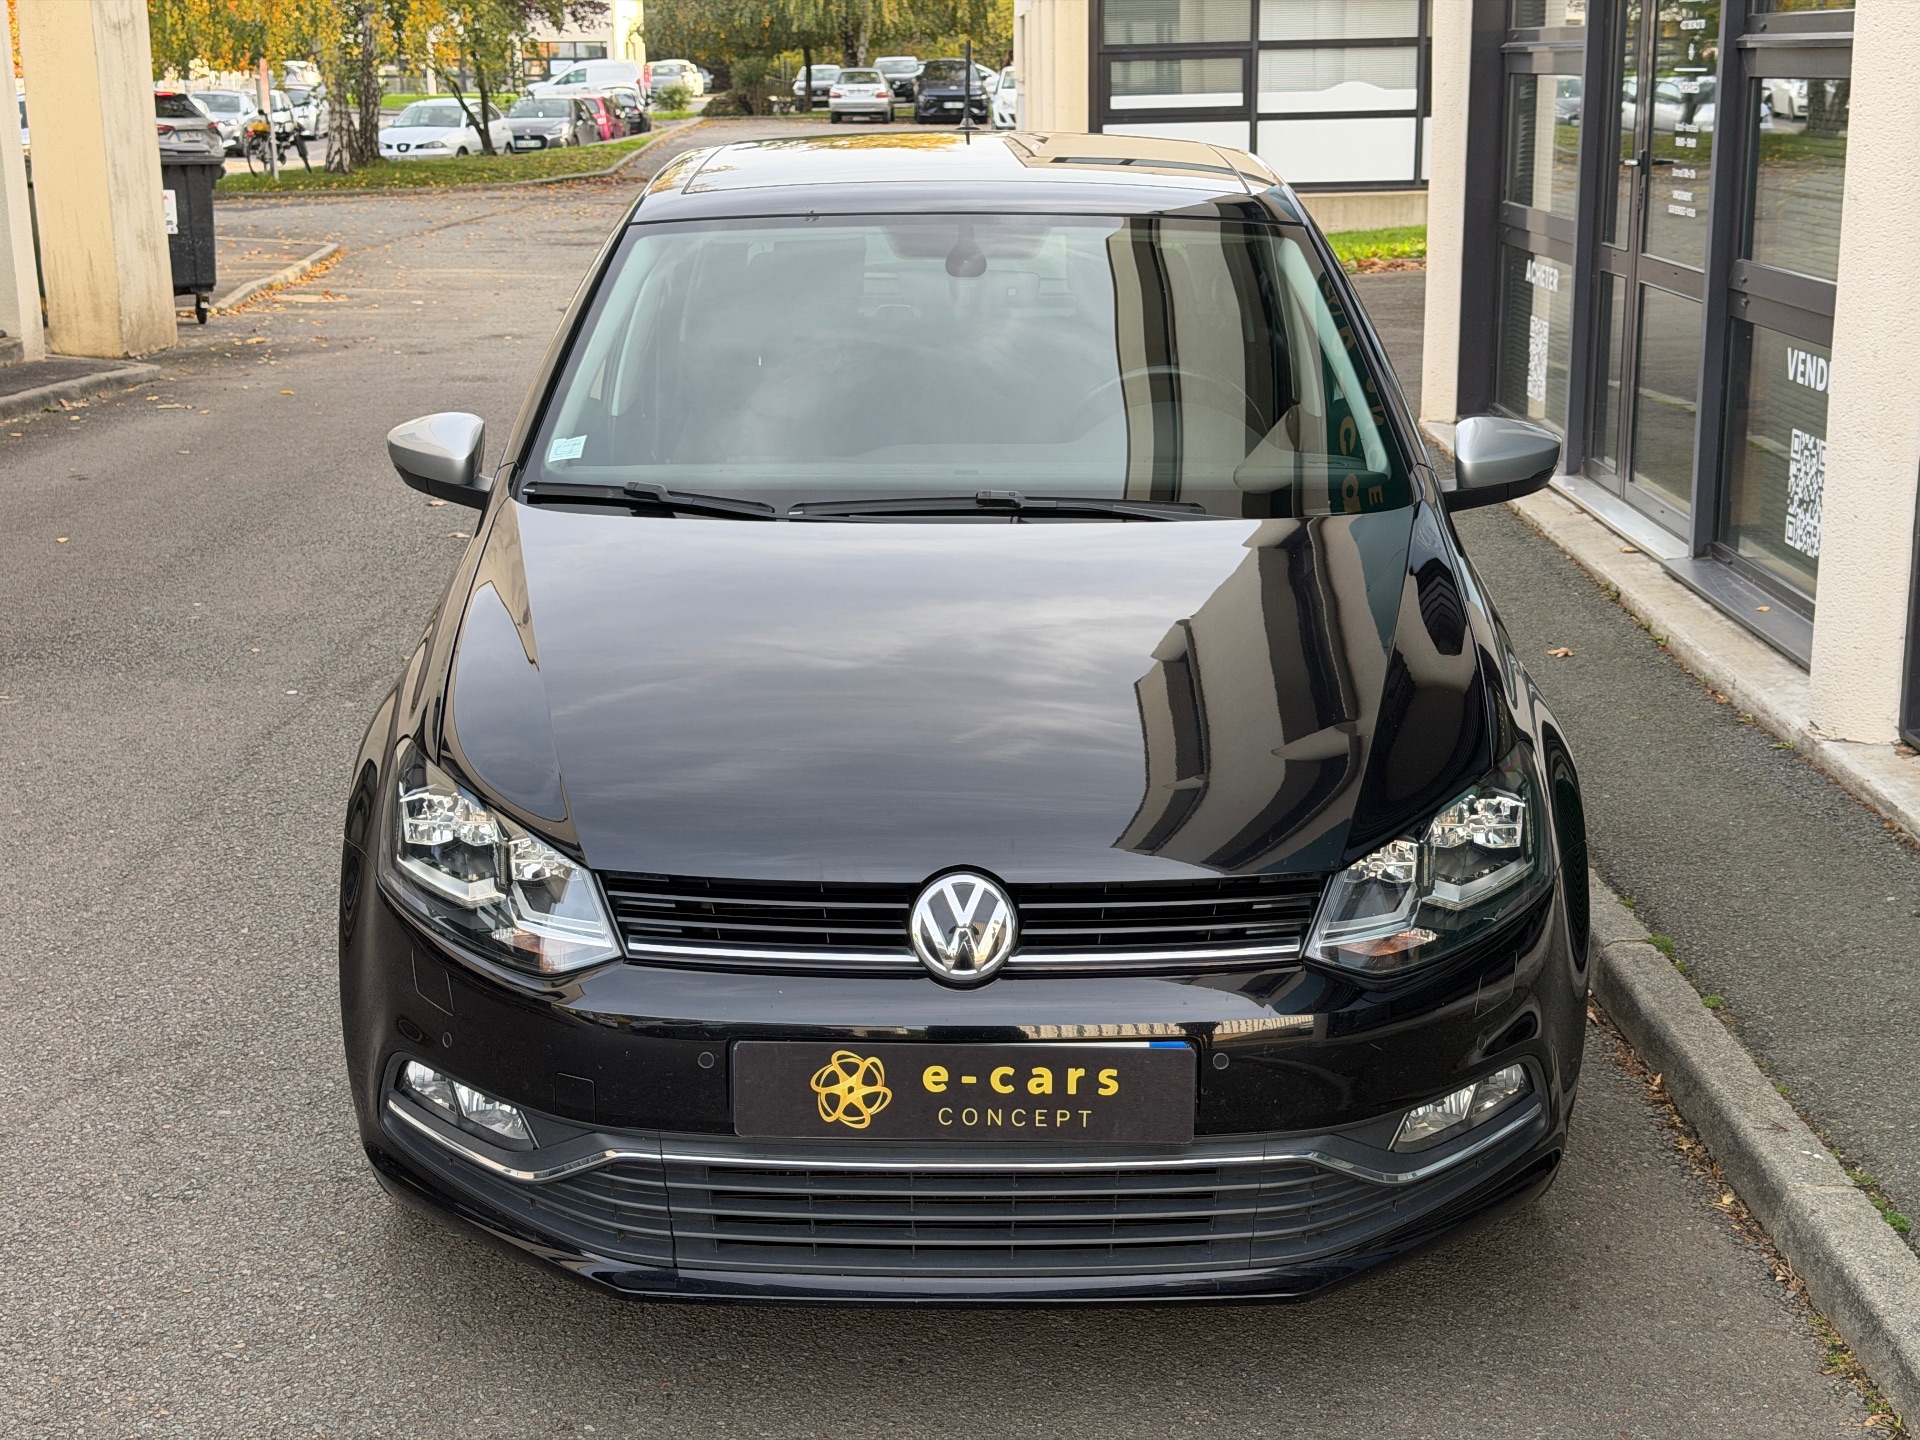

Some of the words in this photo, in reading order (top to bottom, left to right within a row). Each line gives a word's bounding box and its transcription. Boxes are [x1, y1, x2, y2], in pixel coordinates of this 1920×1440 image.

[1525, 259, 1559, 293] ACHETER
[922, 1064, 1120, 1097] e-cars
[937, 1106, 1093, 1129] CONCEPT
